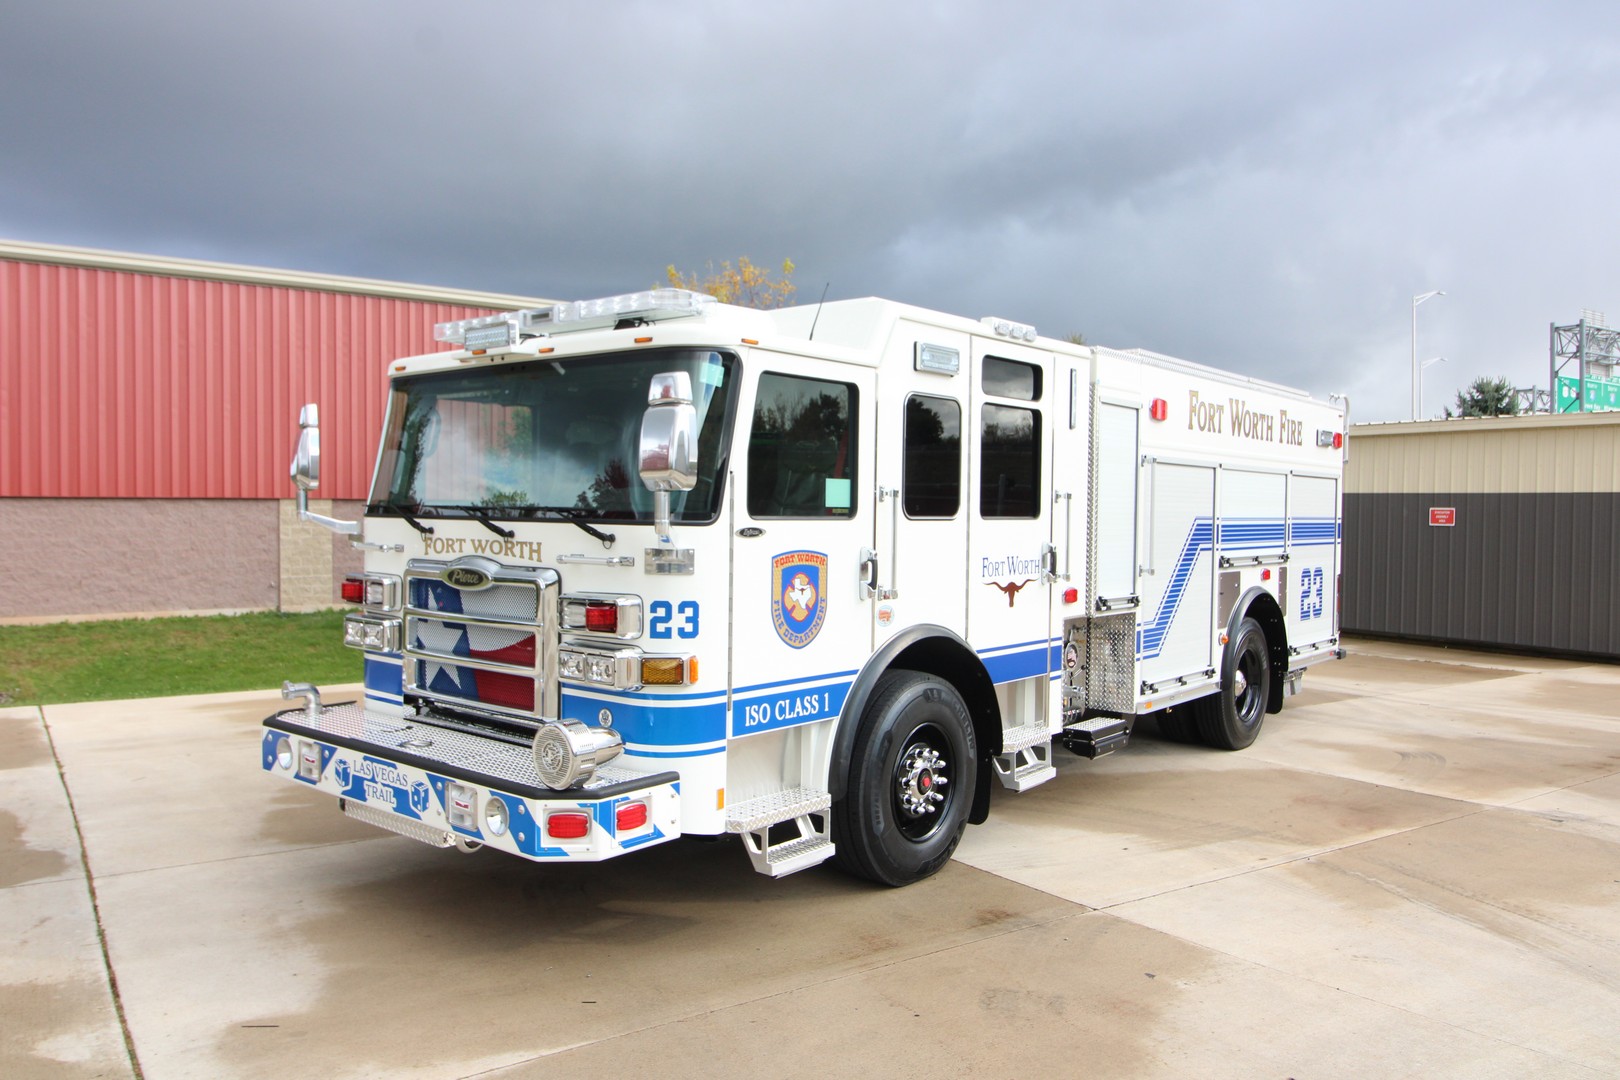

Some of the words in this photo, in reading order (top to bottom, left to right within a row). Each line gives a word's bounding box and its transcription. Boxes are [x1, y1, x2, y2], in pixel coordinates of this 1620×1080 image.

[1188, 390, 1224, 433] FORT
[1229, 398, 1274, 442] WORTH
[1279, 409, 1303, 446] FIRE
[424, 537, 466, 555] FORT
[470, 538, 543, 563] WORTH
[774, 554, 795, 569] FORT
[796, 553, 826, 566] WORTH
[451, 569, 480, 584] Pierce
[982, 557, 1006, 577] FORT
[1006, 555, 1040, 576] WORTH
[1300, 567, 1323, 621] 23
[649, 600, 700, 640] 23
[774, 599, 785, 630] FIRE
[783, 596, 826, 644] DEPARTMENT
[745, 703, 771, 727] ISO
[775, 694, 819, 721] CLASS
[824, 692, 829, 712] 1
[353, 759, 373, 776] LAS
[373, 765, 409, 787] VEGAS
[365, 783, 396, 805] TRAIL
